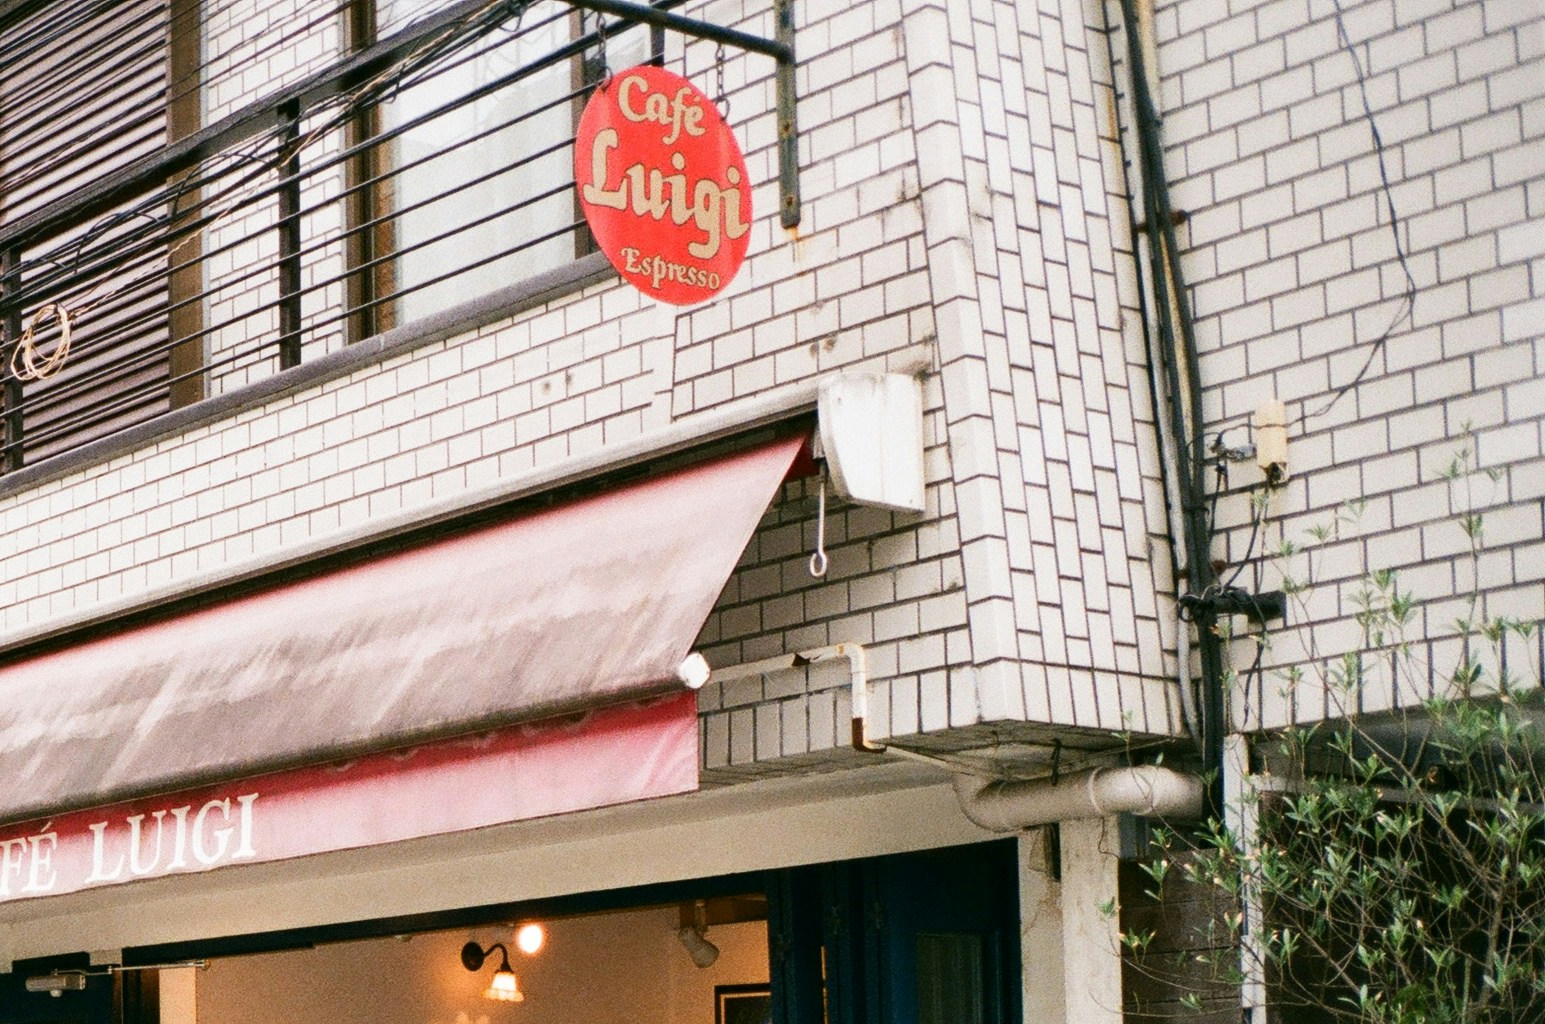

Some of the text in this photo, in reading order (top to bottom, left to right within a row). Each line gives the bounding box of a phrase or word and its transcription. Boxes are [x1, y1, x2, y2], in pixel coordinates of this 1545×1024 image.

[618, 75, 706, 145] Café
[583, 128, 751, 259] Luigi
[621, 247, 721, 290] Espresso
[84, 792, 259, 884] LUIGI
